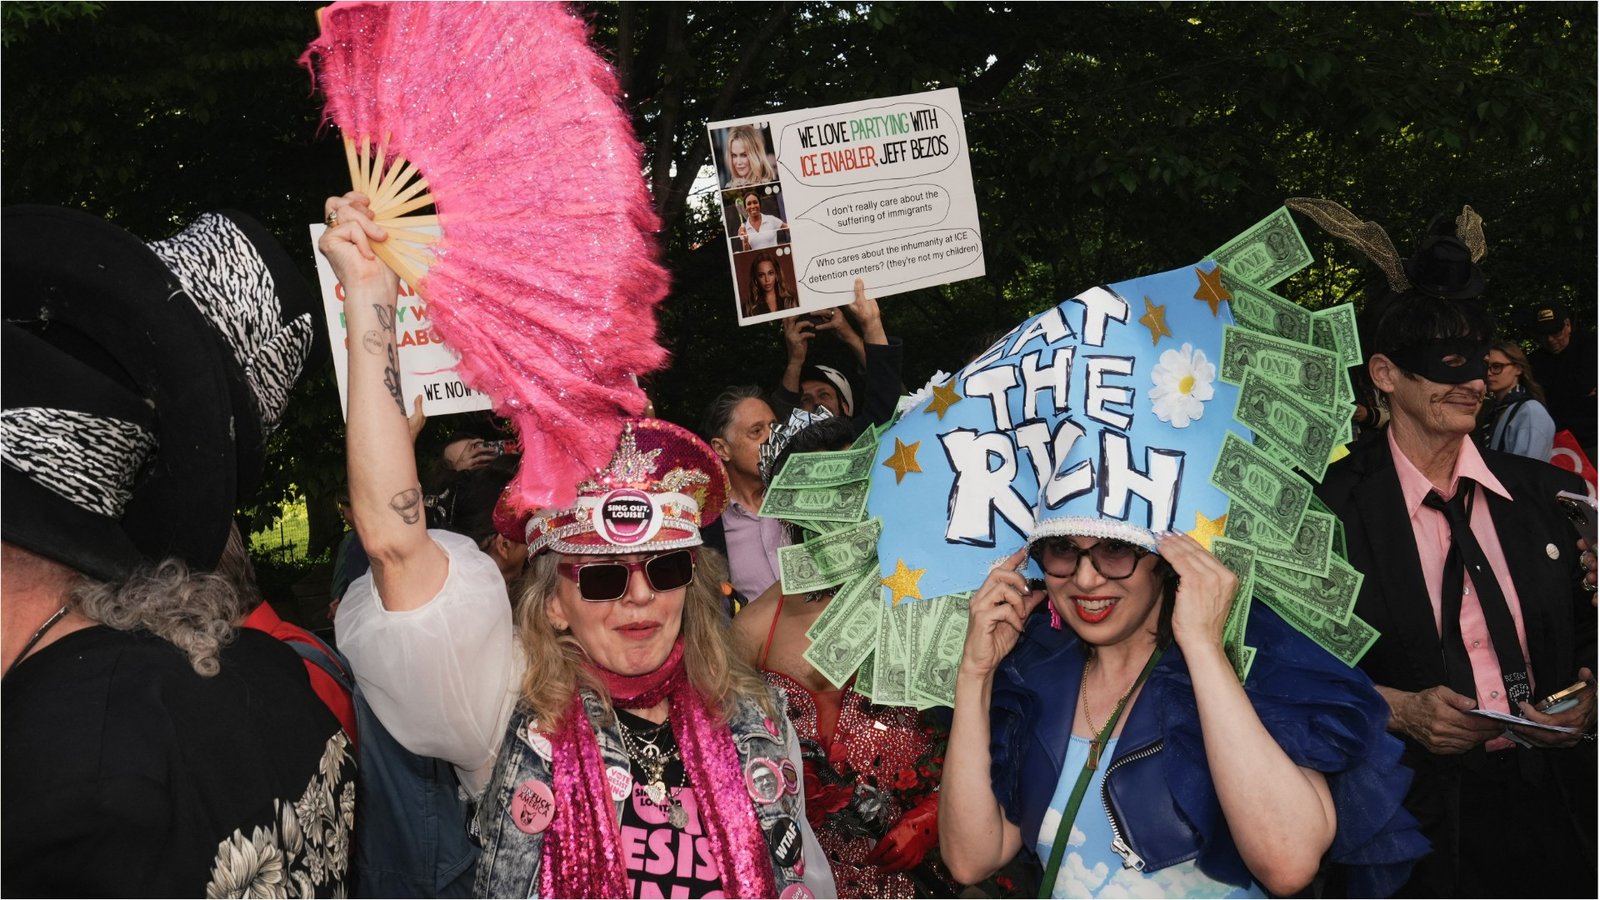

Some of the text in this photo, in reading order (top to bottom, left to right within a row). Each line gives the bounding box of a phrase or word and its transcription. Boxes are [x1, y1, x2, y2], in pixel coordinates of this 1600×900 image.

[798, 109, 939, 148] WE LOVE PARTYING WITH
[800, 135, 948, 177] ICE ENABLER, JEFF BEZOS
[831, 204, 853, 216] don't
[855, 200, 878, 213] really
[880, 198, 899, 208] care
[900, 193, 923, 205] about
[925, 190, 939, 200] the
[837, 204, 932, 228] suffering of immigrants
[809, 243, 979, 283] detention centers? (they're not my children)
[816, 232, 968, 268] Who cares about the inhumanity at ICE
[960, 286, 1131, 380] EAT
[1260, 354, 1296, 377] ONE
[424, 383, 442, 400] WE
[964, 346, 1136, 433] THE
[1273, 407, 1302, 438] ONE
[937, 417, 1186, 547] RICH
[1248, 470, 1277, 499] ONE
[846, 607, 874, 640] ONE
[942, 622, 964, 656] ONE
[612, 769, 630, 784] VOTE
[518, 792, 547, 817] AMERICA
[621, 825, 720, 881] ESIS
[776, 822, 797, 859] WTAF
